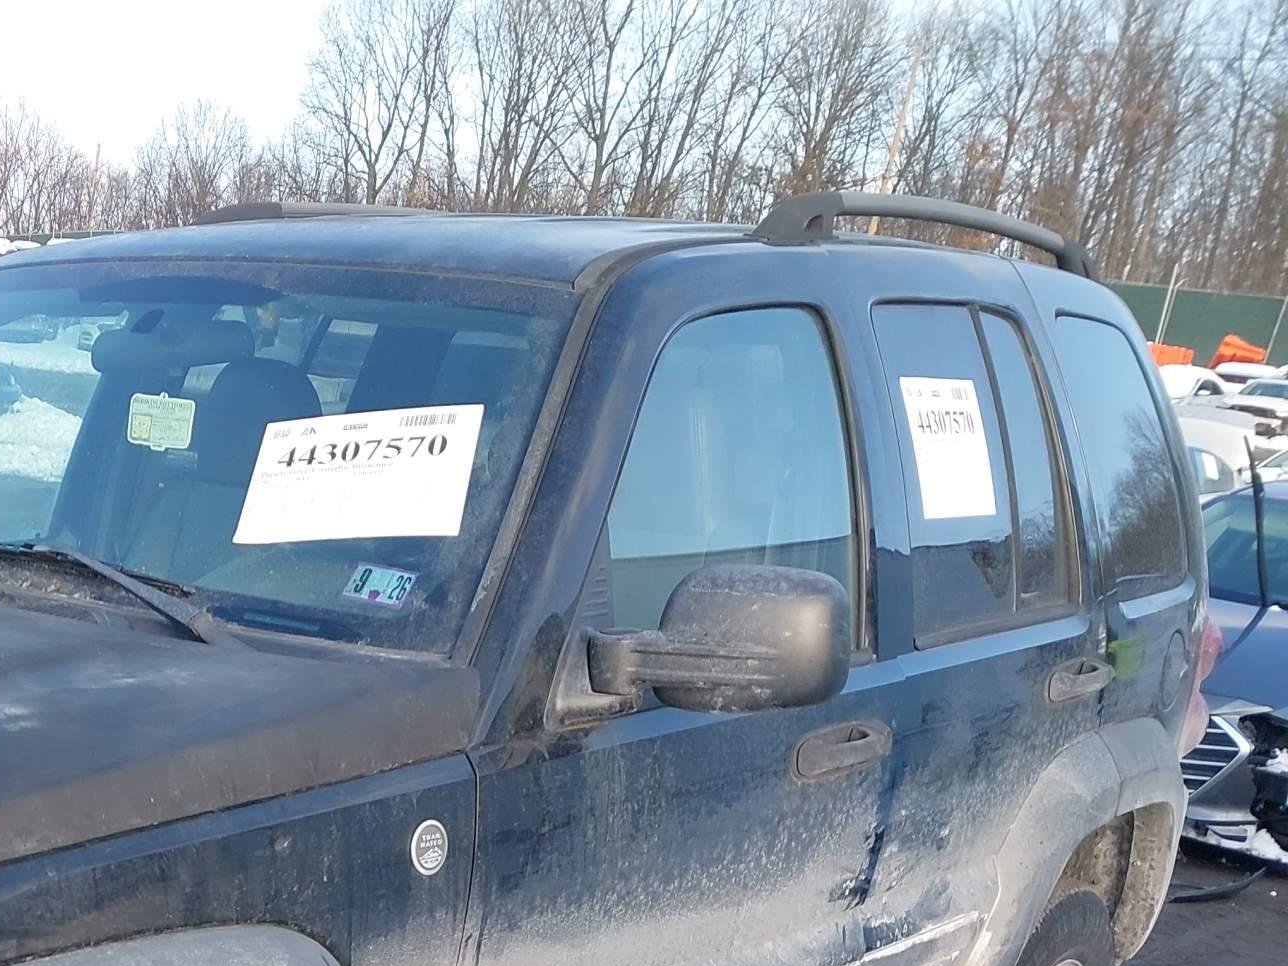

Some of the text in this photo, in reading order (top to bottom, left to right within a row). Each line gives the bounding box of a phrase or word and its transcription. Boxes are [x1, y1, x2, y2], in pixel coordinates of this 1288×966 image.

[917, 409, 975, 435] 44307570
[276, 433, 449, 468] 44307570
[353, 567, 413, 601] 9 26
